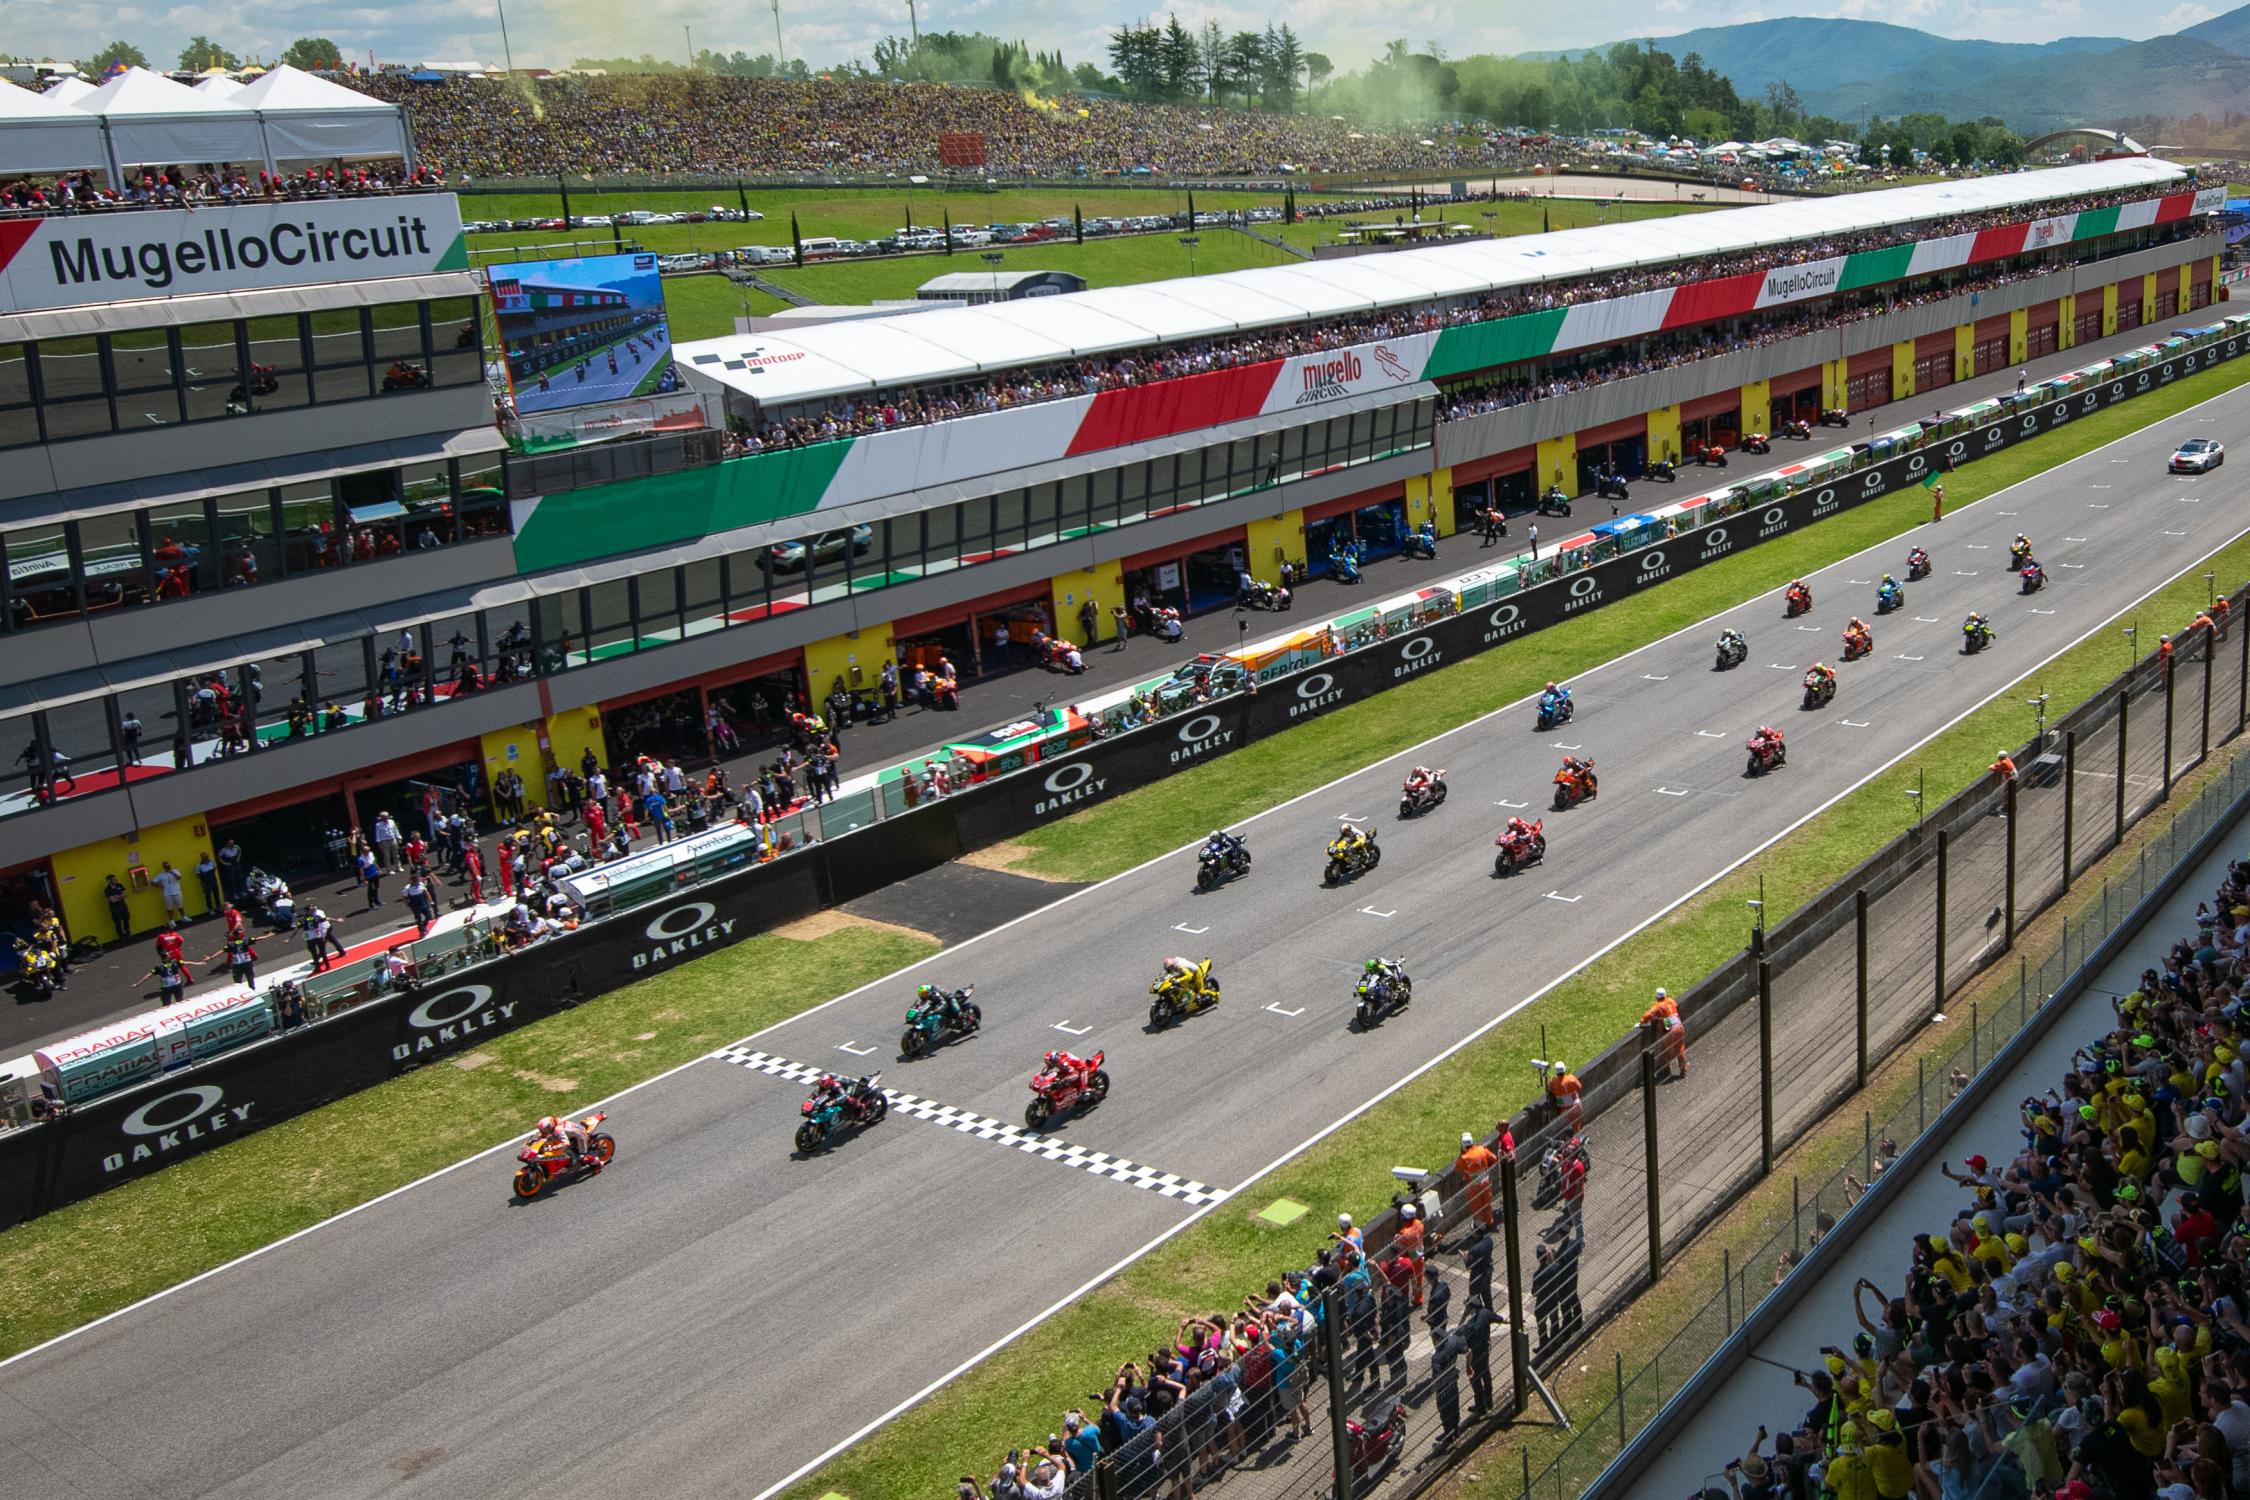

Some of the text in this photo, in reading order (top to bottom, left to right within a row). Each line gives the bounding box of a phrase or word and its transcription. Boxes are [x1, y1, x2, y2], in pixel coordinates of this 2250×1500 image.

[49, 215, 431, 288] MugelloCircuit
[1768, 267, 1835, 298] MugelloCircuit
[1303, 351, 1361, 389] mugello
[1296, 384, 1349, 404] CIRCUIT
[1701, 541, 1733, 559] OAKLEY
[1637, 564, 1671, 584] OAKLEY
[1565, 590, 1603, 612] OAKLEY
[1484, 619, 1526, 643] OAKLEY
[1394, 652, 1441, 678] OAKLEY
[1289, 689, 1343, 717] OAKLEY
[1170, 730, 1232, 763] OAKLEY
[1035, 778, 1107, 815] OAKLEY
[632, 919, 735, 969] OAKLEY
[160, 992, 254, 1027] PRAMAC
[55, 1024, 154, 1063] PRAMAC
[393, 1002, 516, 1060] OAKLEY
[103, 1102, 252, 1172] OAKLEY
